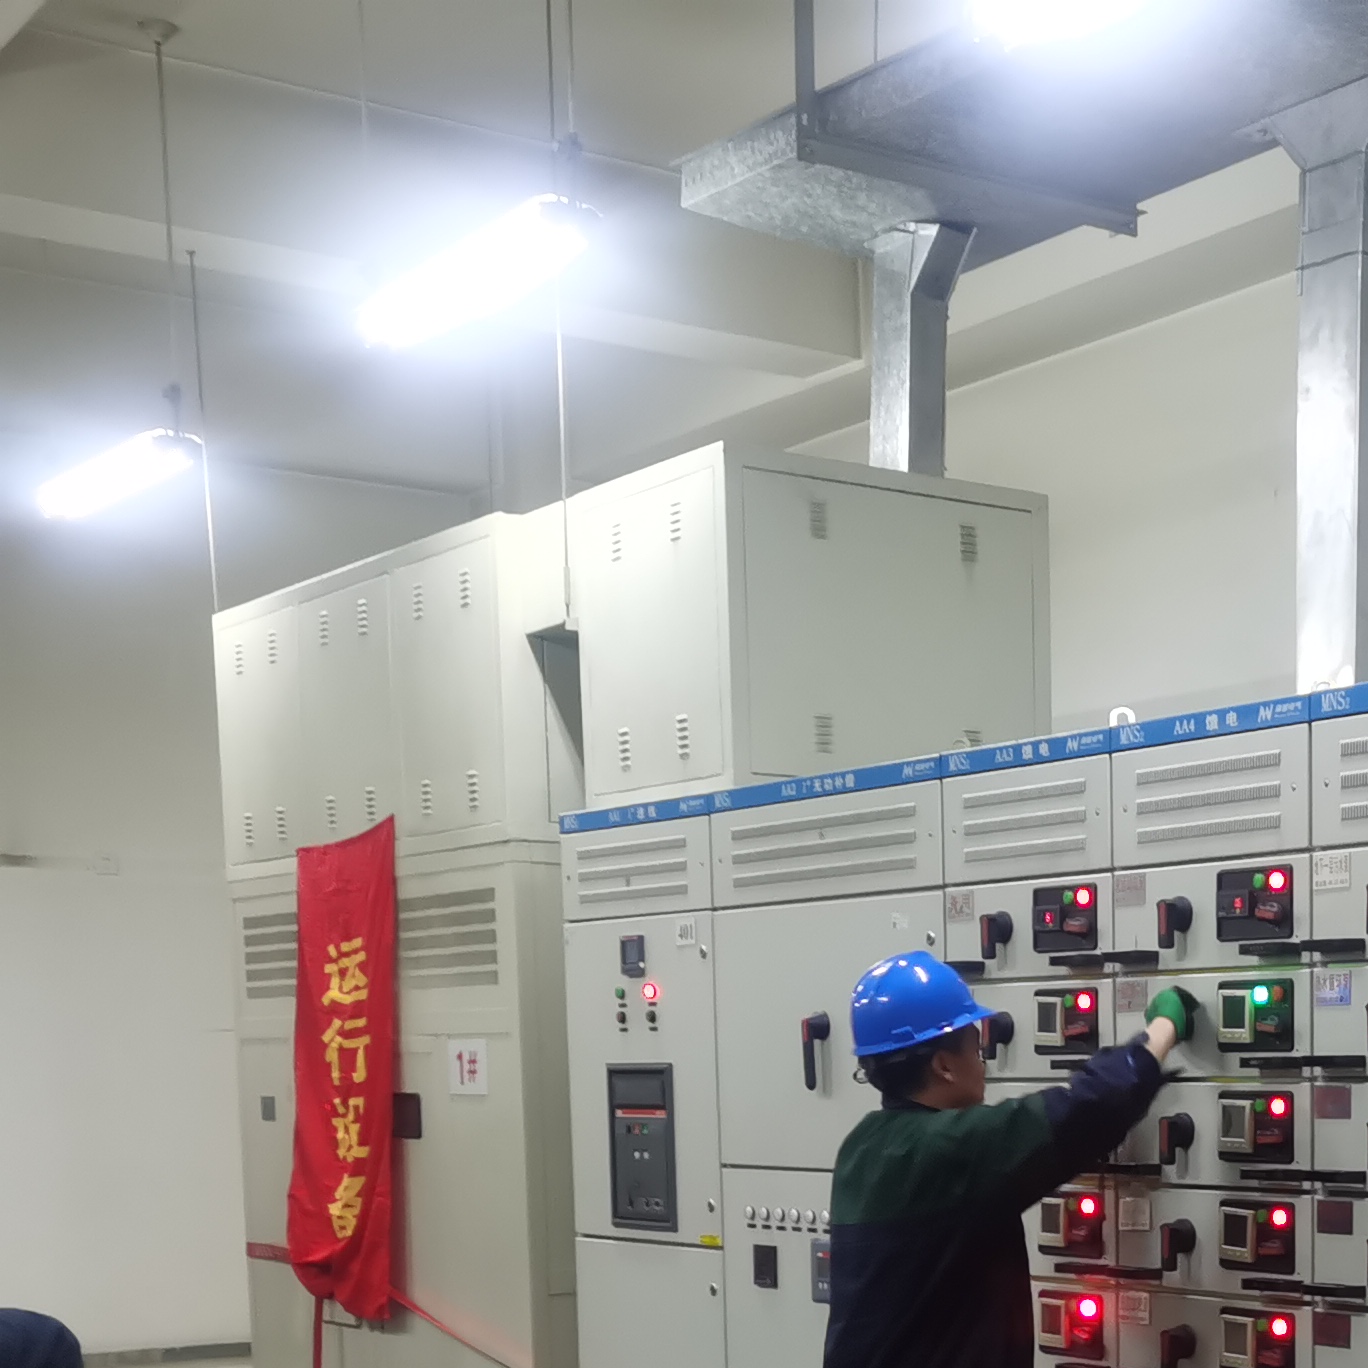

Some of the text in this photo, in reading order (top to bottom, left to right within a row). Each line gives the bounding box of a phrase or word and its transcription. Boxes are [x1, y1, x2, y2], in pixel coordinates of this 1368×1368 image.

[1173, 718, 1196, 736] AA4
[994, 747, 1014, 764] AA3
[456, 1049, 479, 1086] 1#
[321, 936, 372, 1239] 运行设备
